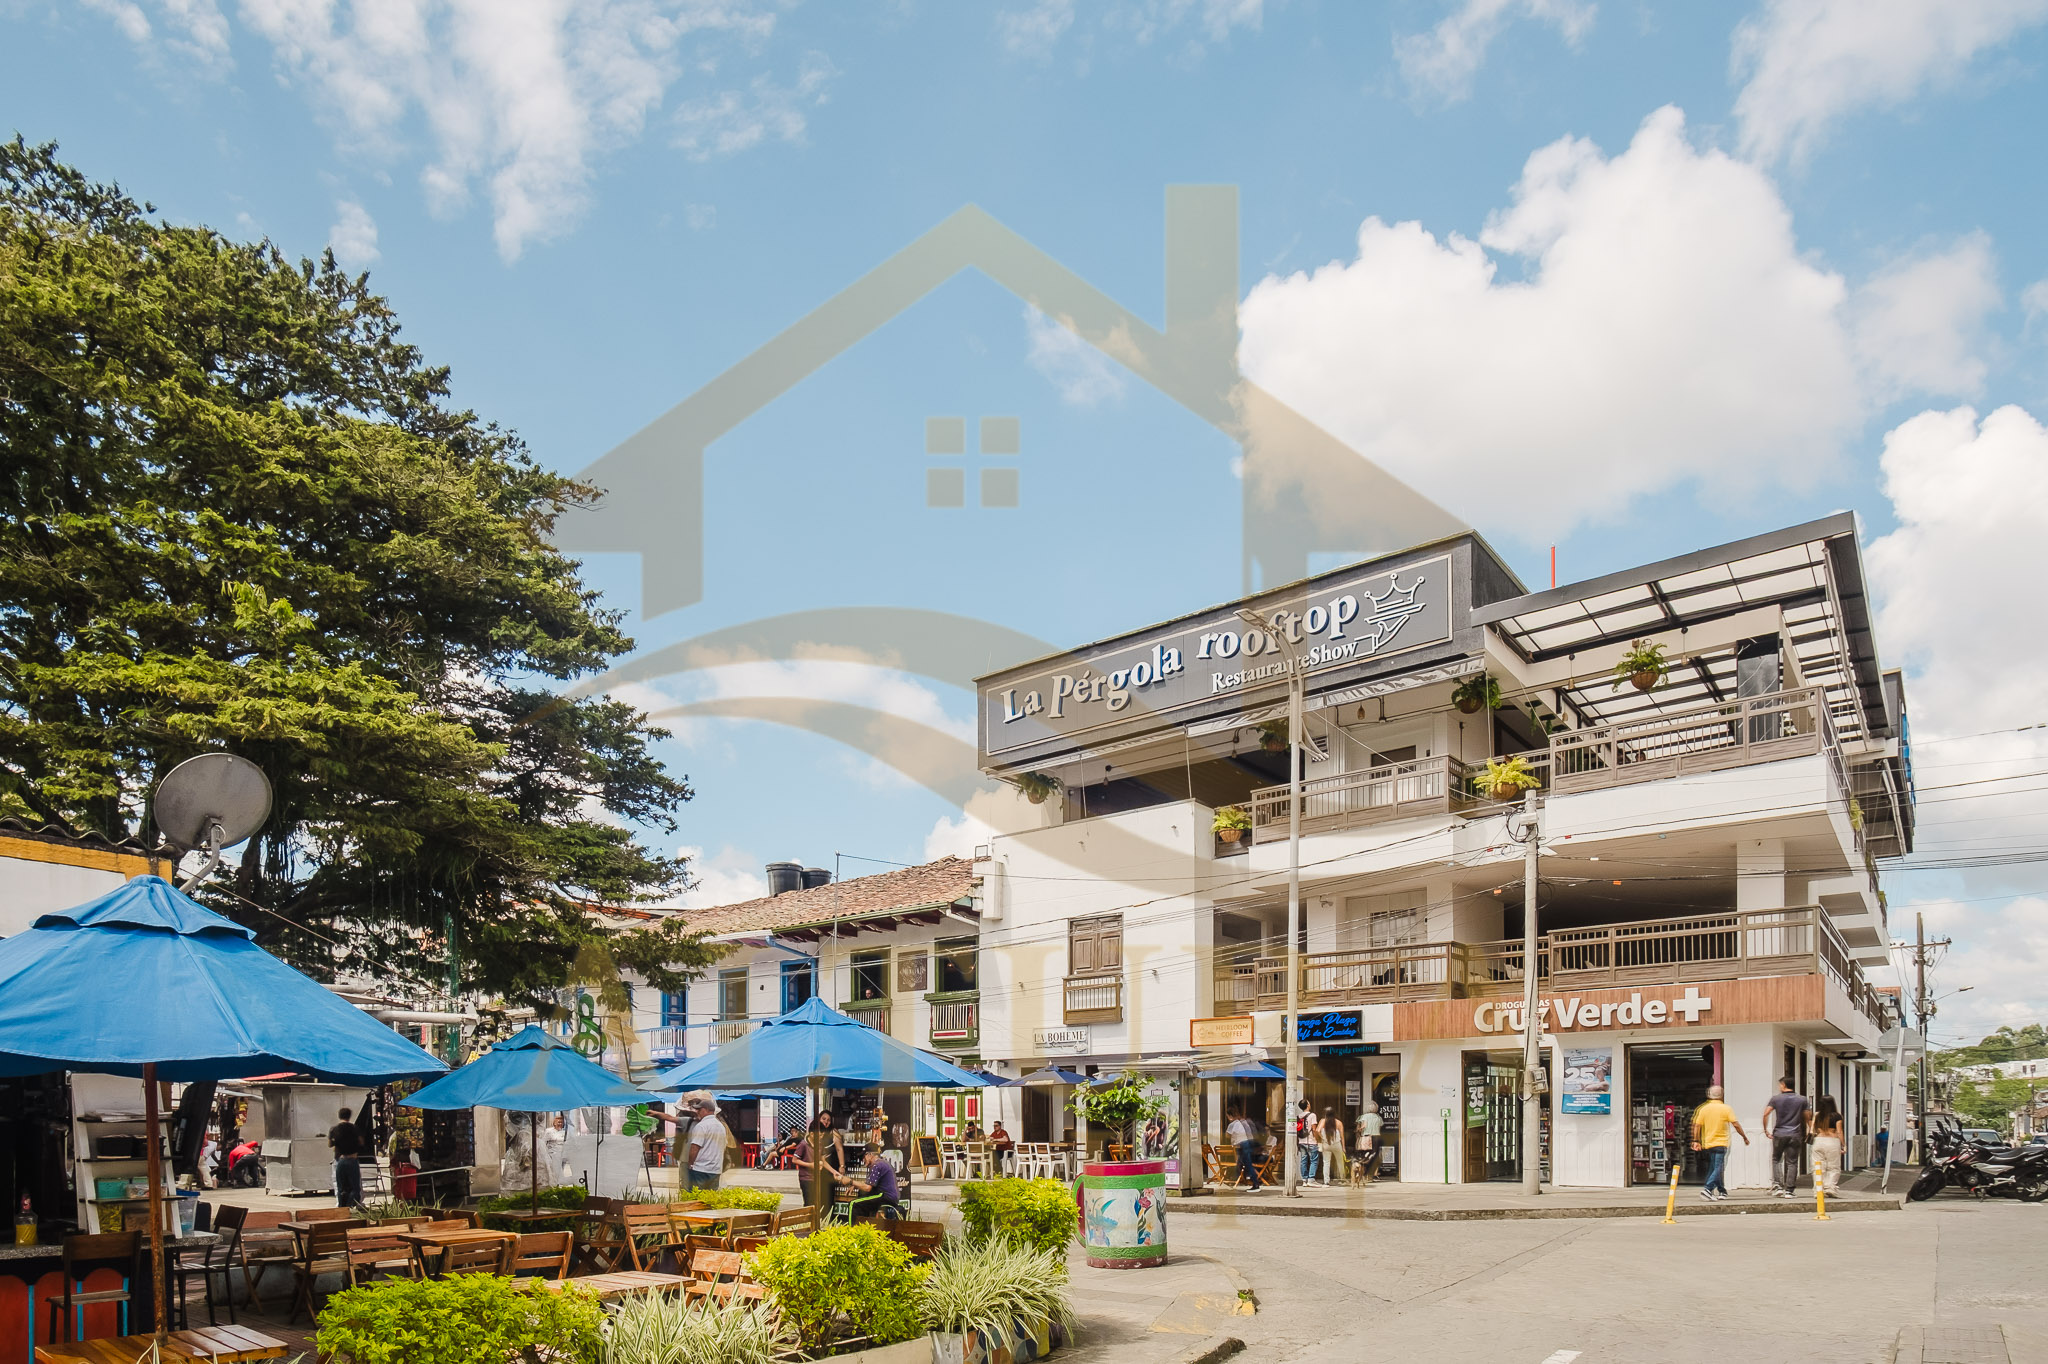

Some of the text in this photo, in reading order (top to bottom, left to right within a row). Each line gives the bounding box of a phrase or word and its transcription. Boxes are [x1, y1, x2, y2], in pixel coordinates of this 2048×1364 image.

[1000, 688, 1044, 724] La
[1196, 594, 1359, 660] rooftop
[1495, 999, 1550, 1010] DROGUAS
[1552, 992, 1667, 1028] Verde
[1034, 1033, 1045, 1042] LA
[1469, 1086, 1484, 1108] 35
